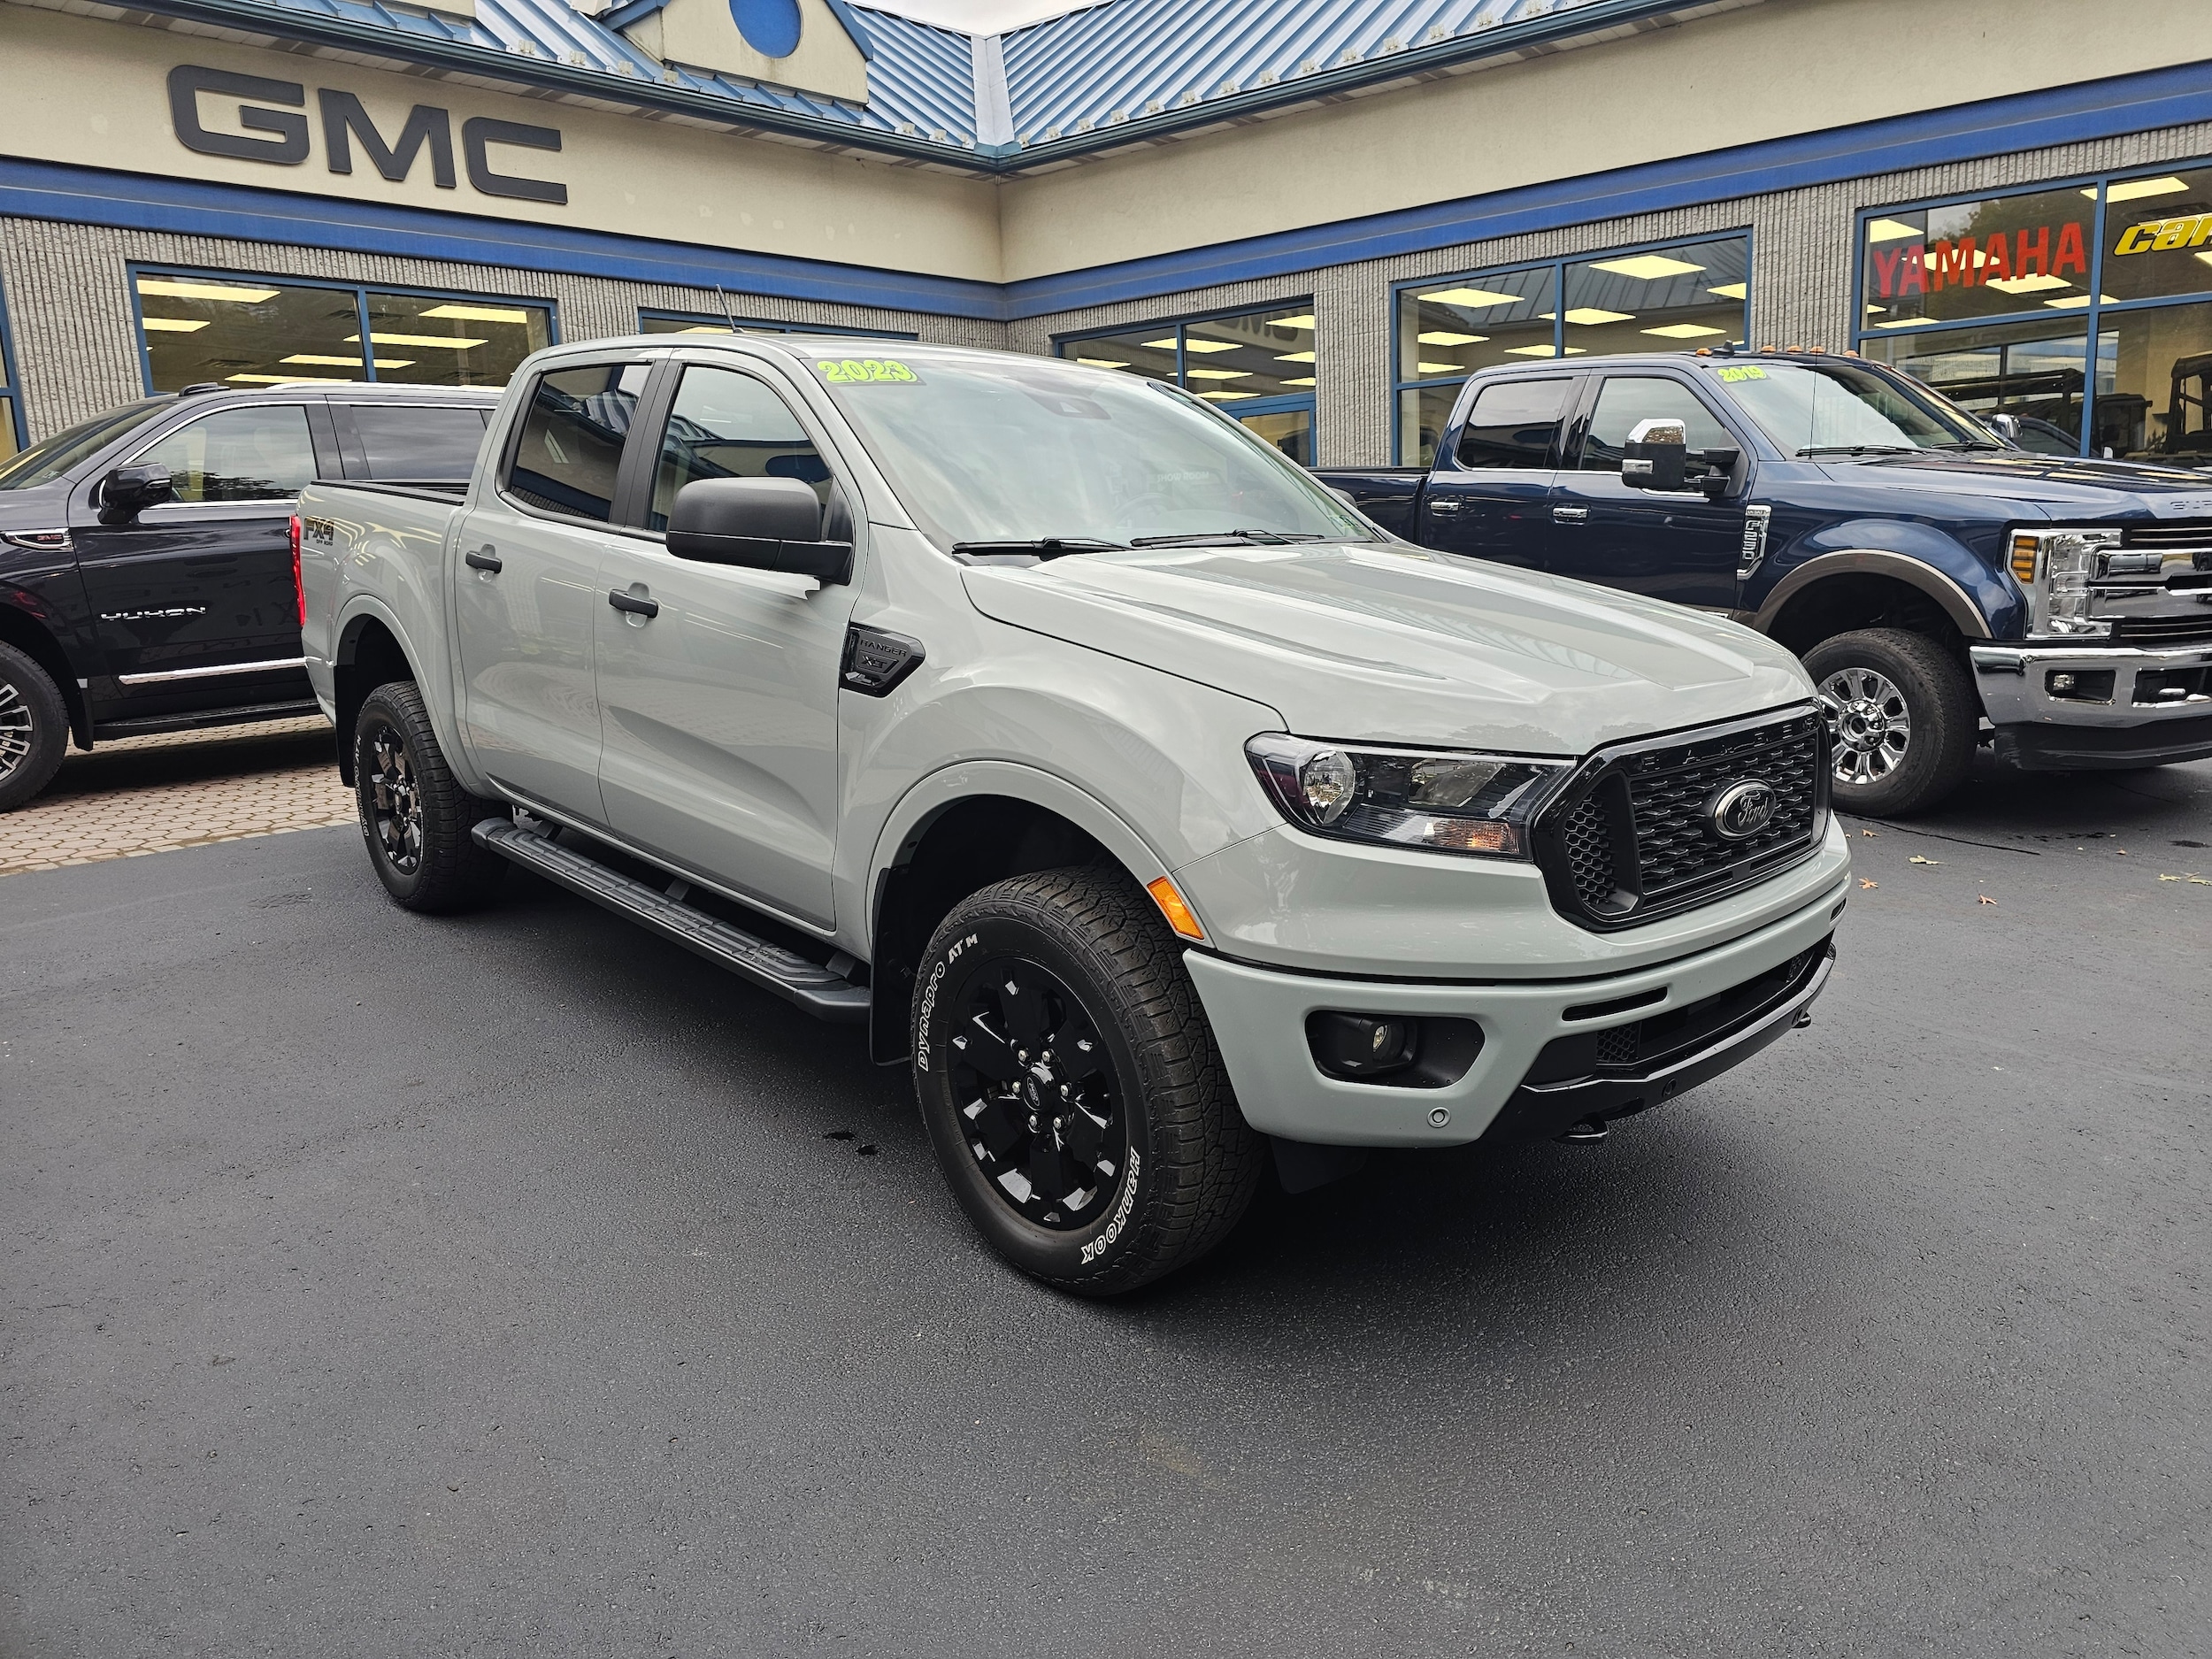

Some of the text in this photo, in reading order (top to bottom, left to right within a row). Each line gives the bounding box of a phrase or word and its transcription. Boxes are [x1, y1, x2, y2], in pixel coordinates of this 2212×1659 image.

[167, 65, 568, 205] GMC
[1872, 222, 2086, 299] YAMAHA
[817, 359, 918, 383] 2023
[1717, 365, 1767, 383] 2019
[303, 516, 334, 541] FX4
[100, 607, 206, 621] YUKON
[860, 638, 908, 657] RANGER
[1737, 789, 1770, 827] Ford
[918, 961, 946, 1072] Dynapro
